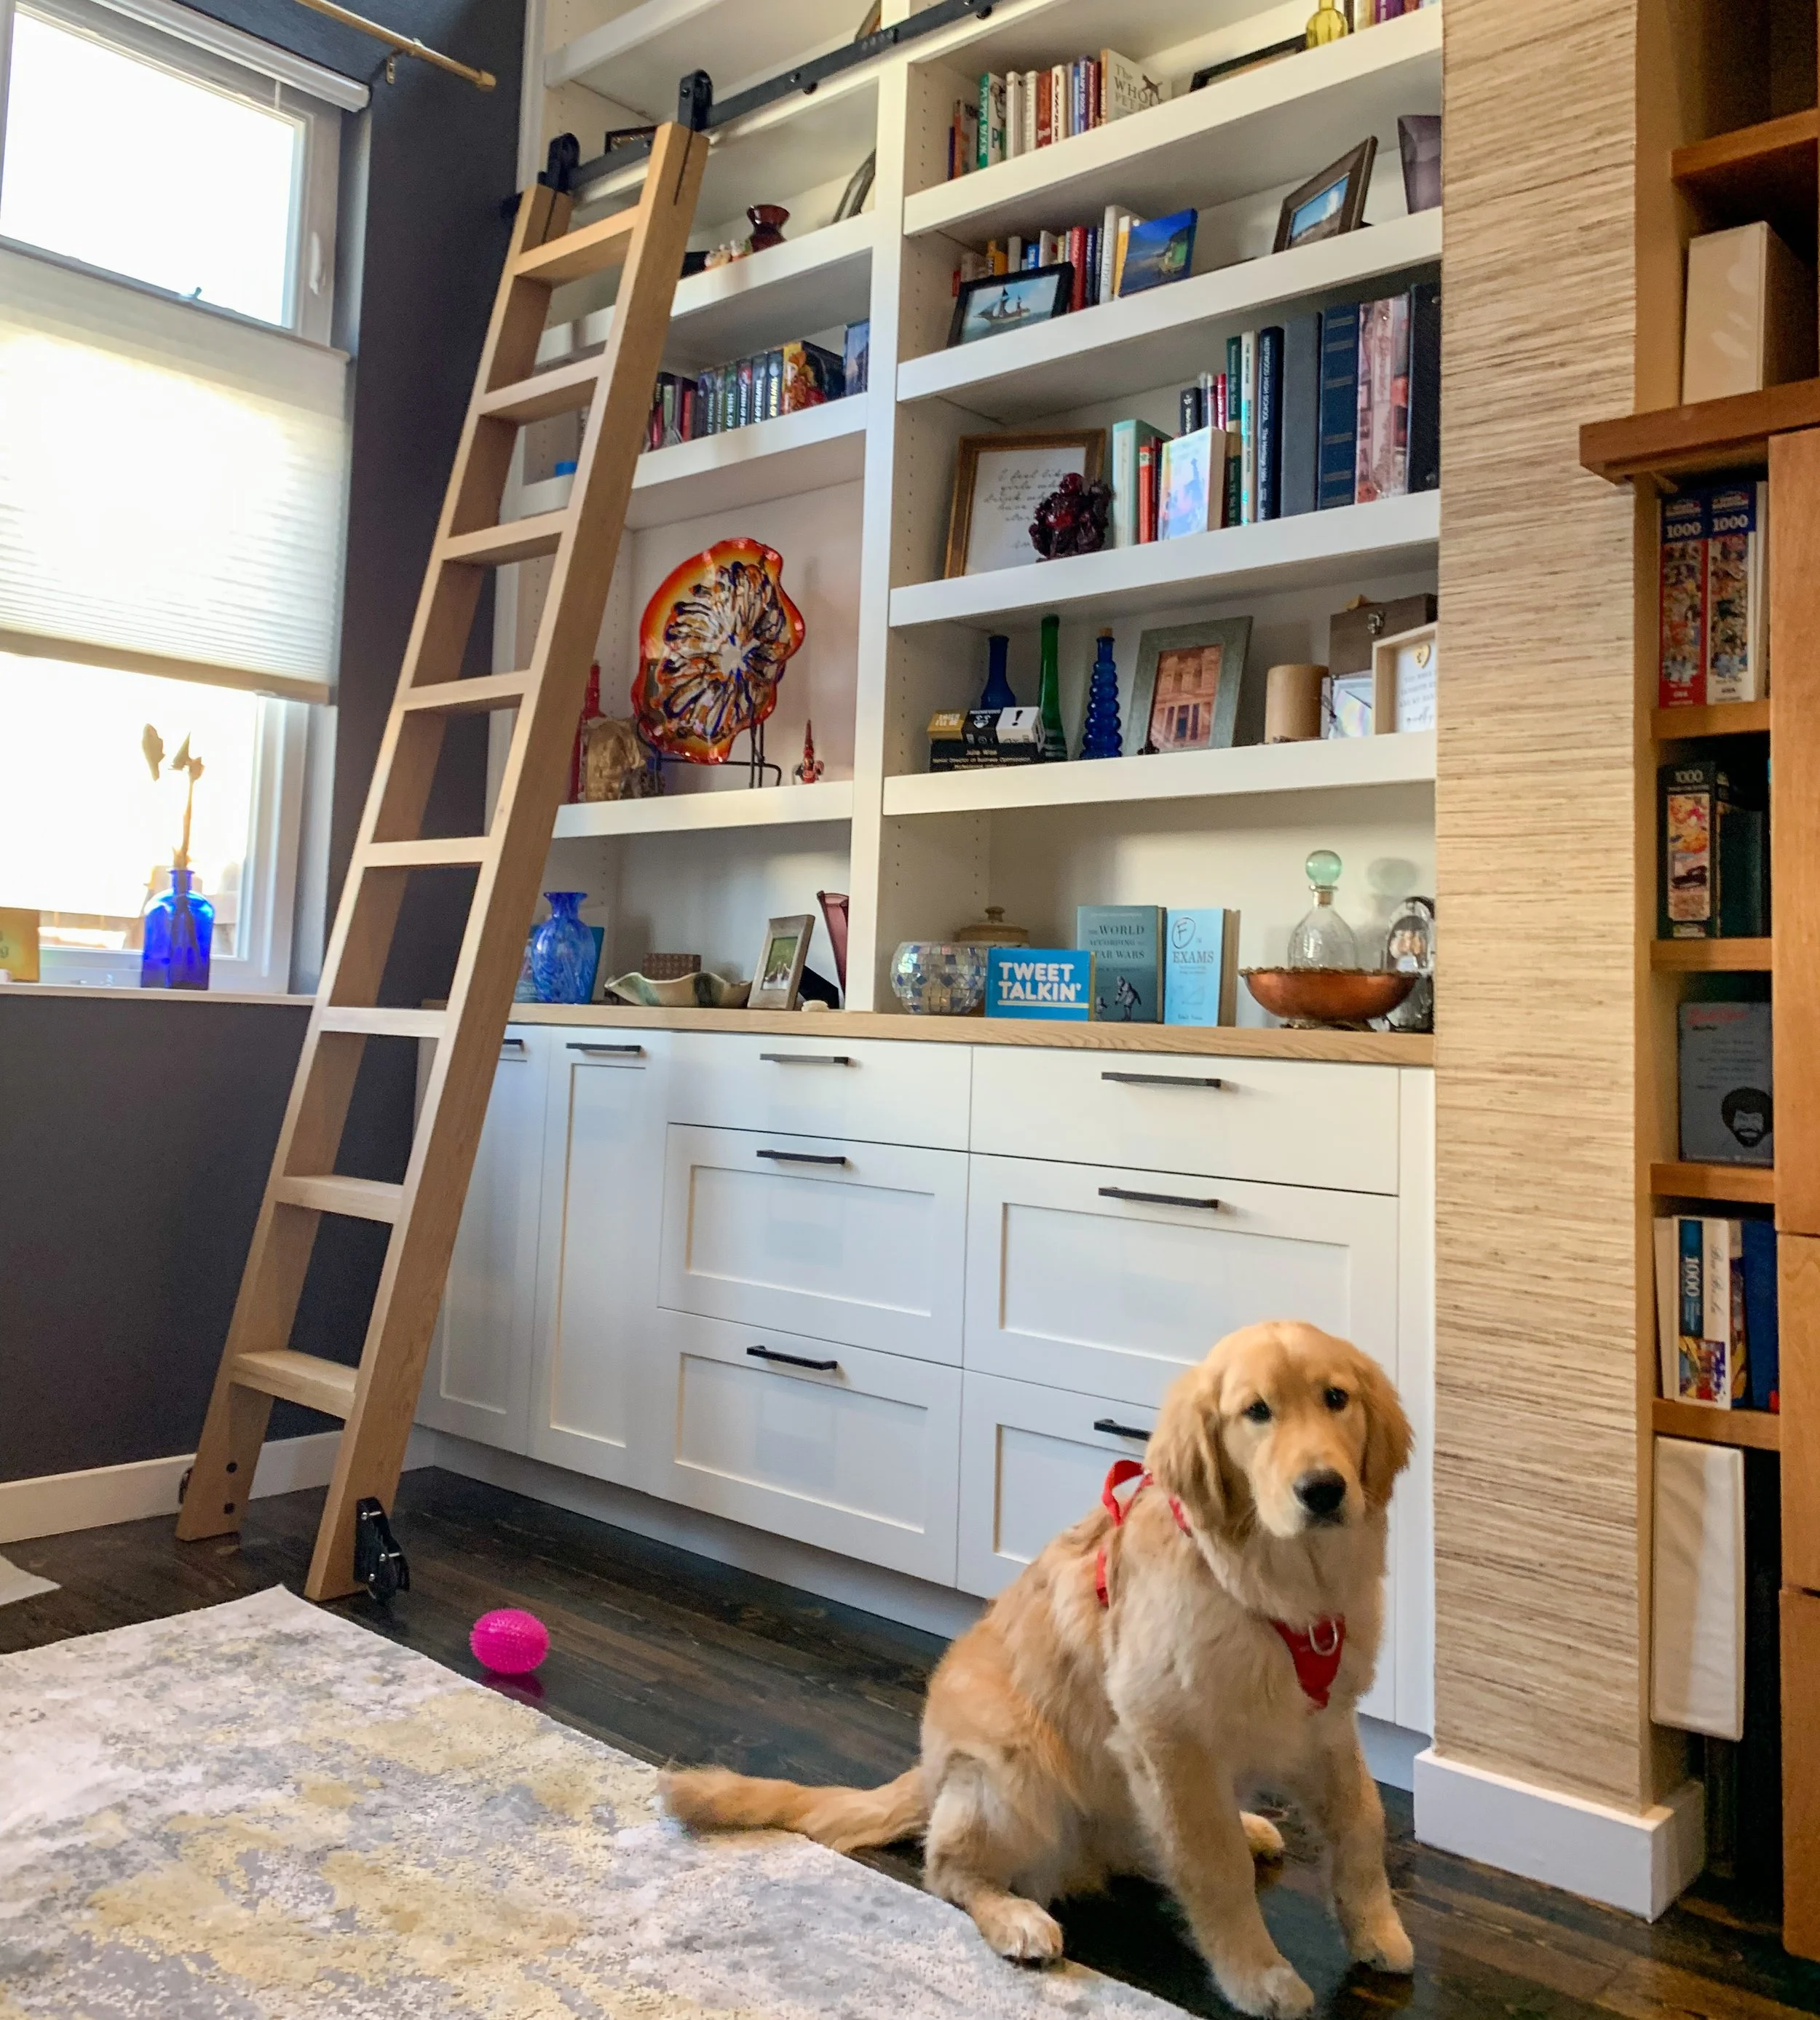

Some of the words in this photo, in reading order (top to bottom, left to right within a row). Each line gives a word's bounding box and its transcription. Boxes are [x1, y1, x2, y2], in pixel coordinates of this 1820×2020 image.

[1667, 522, 1701, 538] 1000
[1712, 514, 1748, 532] 1000
[1675, 769, 1704, 784] 1000
[1099, 924, 1145, 935] WORLD
[1095, 950, 1112, 959] TAR
[1116, 950, 1145, 959] WARS
[1173, 950, 1214, 964] EXAMS
[998, 962, 1075, 982] TWEET
[998, 981, 1082, 1002] TALKIN'
[1685, 1256, 1701, 1297] 1000
